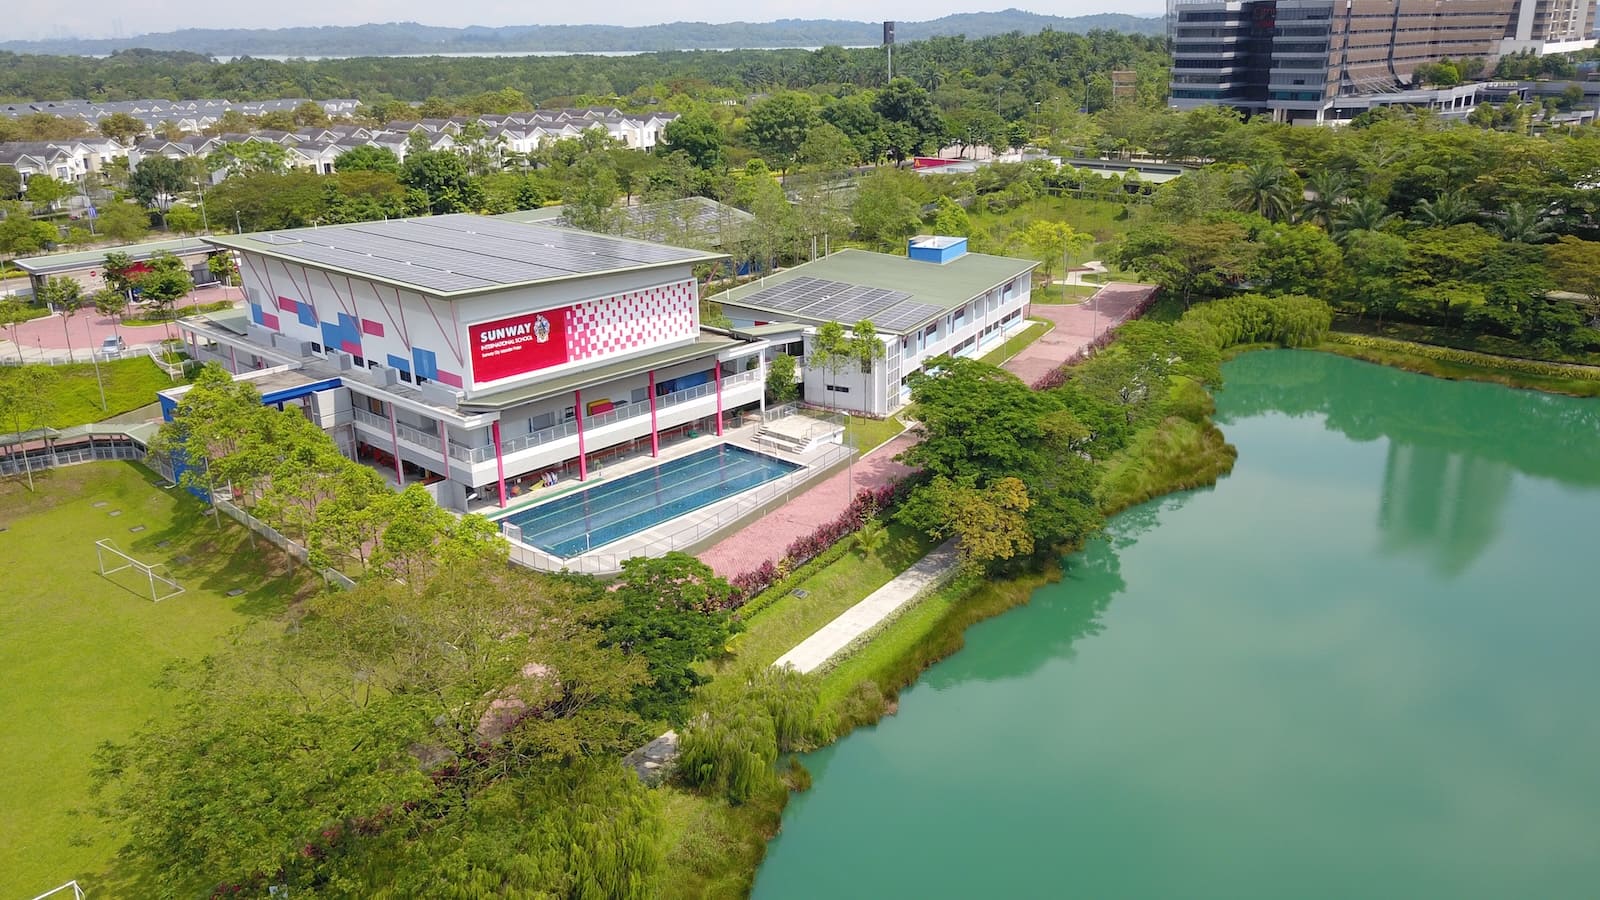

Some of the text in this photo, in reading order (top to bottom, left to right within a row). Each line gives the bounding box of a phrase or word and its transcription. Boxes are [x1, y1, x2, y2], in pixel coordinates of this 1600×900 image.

[480, 323, 531, 343] SUNWAY
[481, 335, 533, 351] INTERNATIONAL SCHOOL
